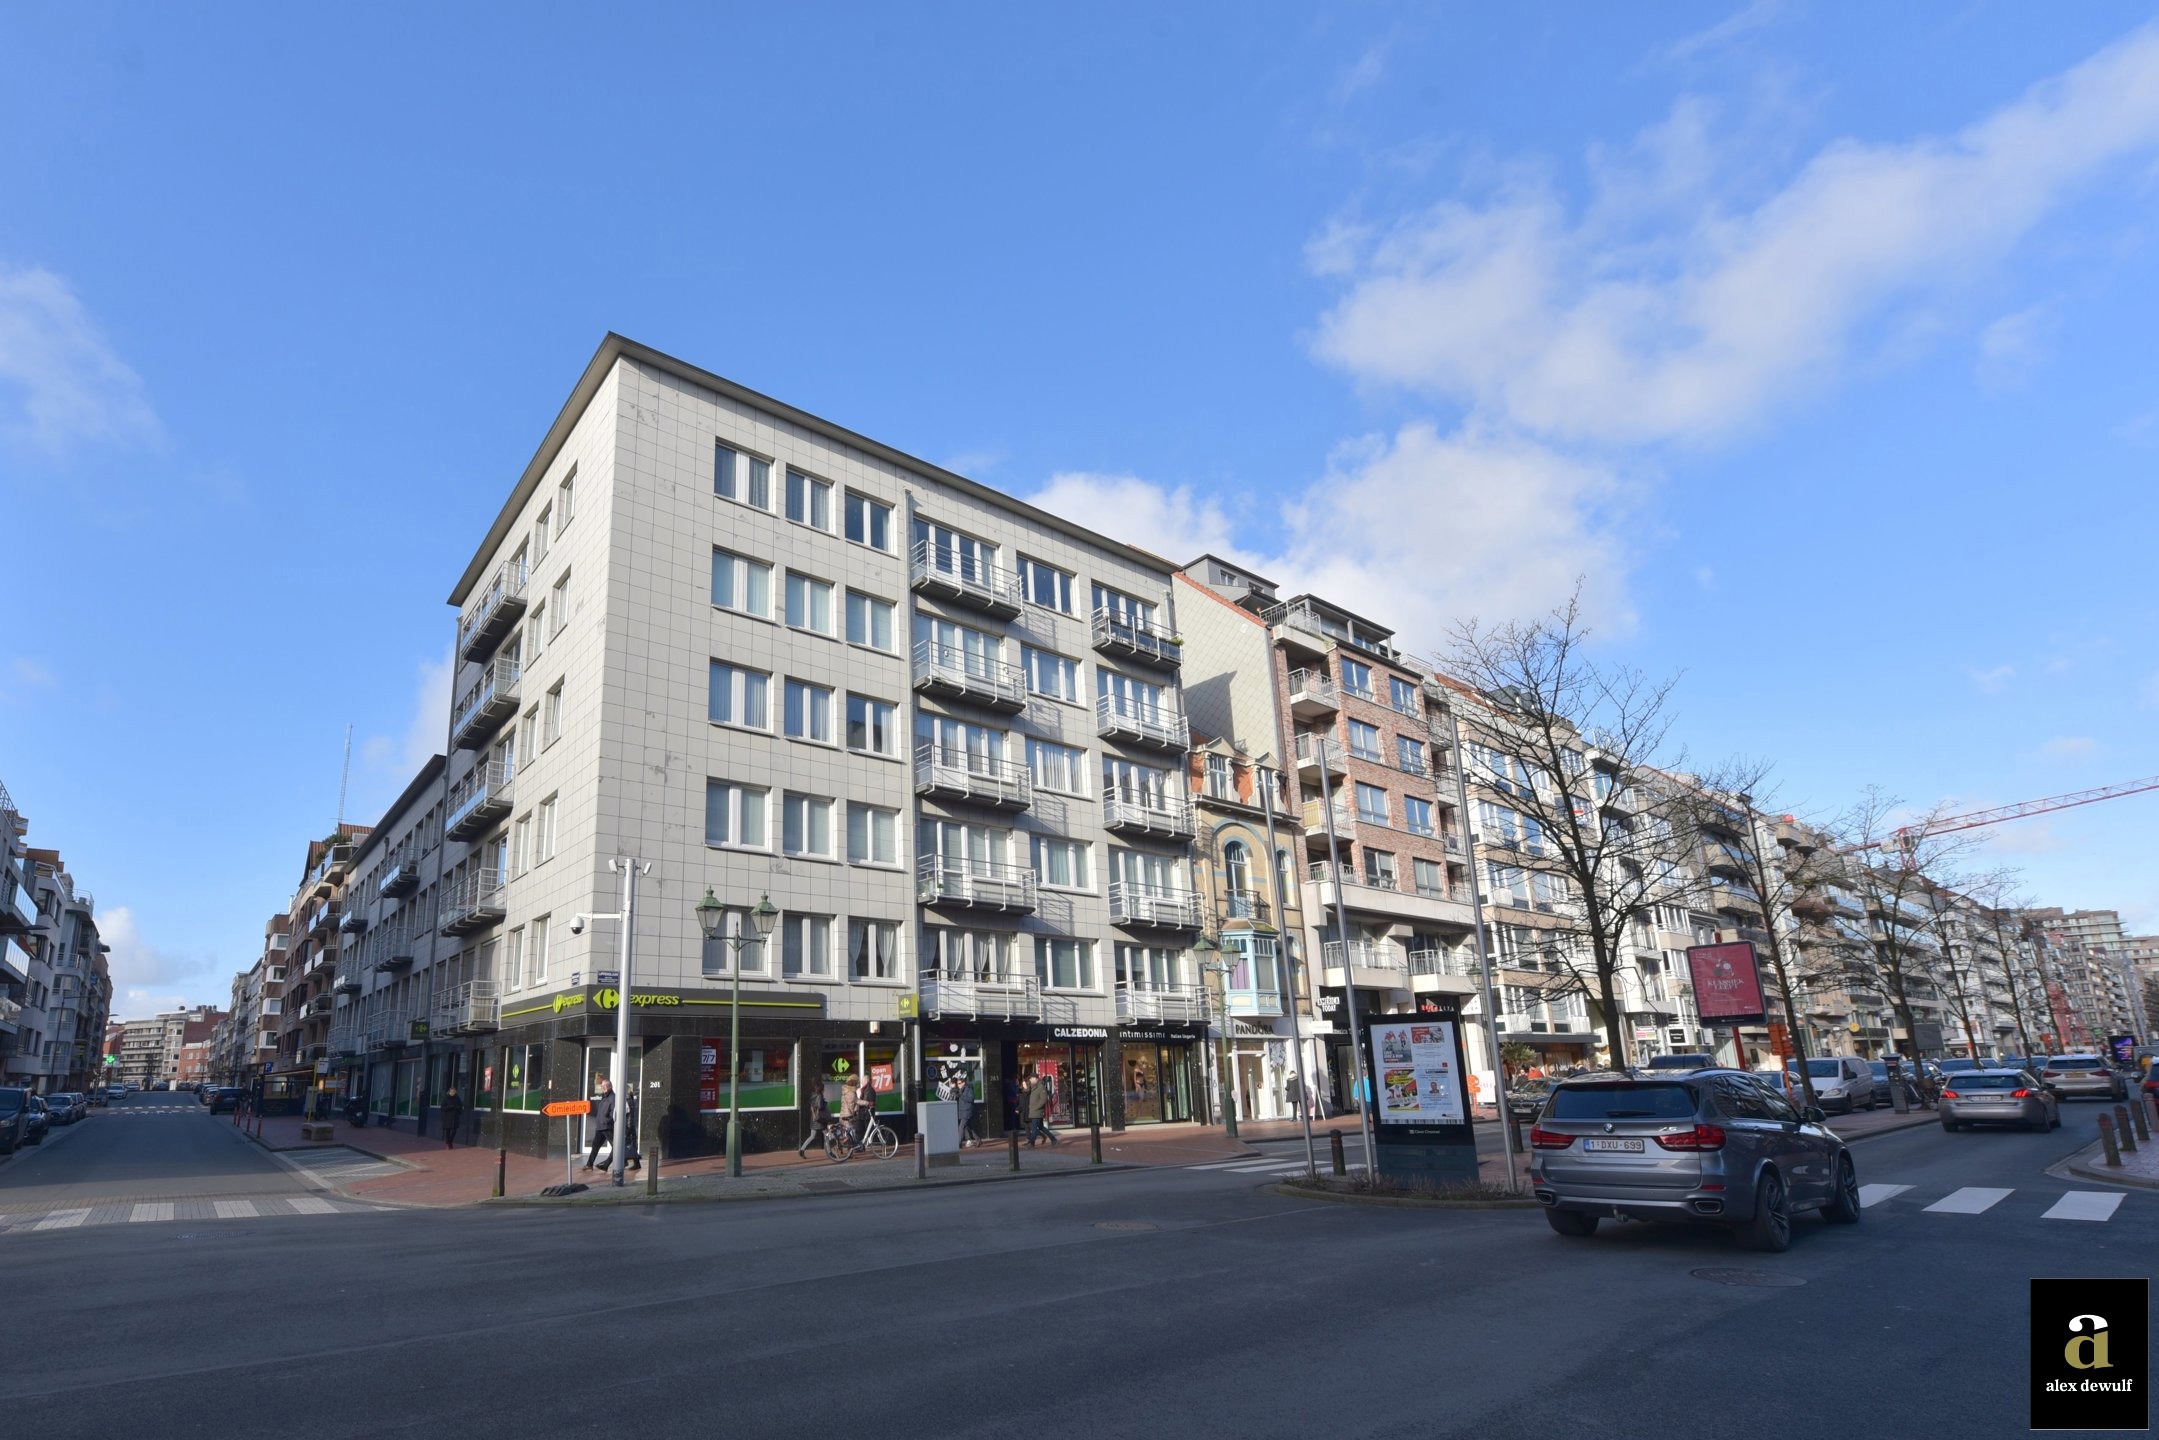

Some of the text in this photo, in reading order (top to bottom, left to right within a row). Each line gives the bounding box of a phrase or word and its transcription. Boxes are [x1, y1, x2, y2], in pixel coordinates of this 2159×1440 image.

[562, 993, 585, 1008] express
[629, 994, 680, 1008] express
[1054, 1027, 1108, 1038] CALZEDONIA
[1235, 1022, 1274, 1035] PANDORA
[702, 1054, 716, 1063] 7/7
[872, 1074, 892, 1089] 7/7
[550, 1103, 587, 1113] Omleiding
